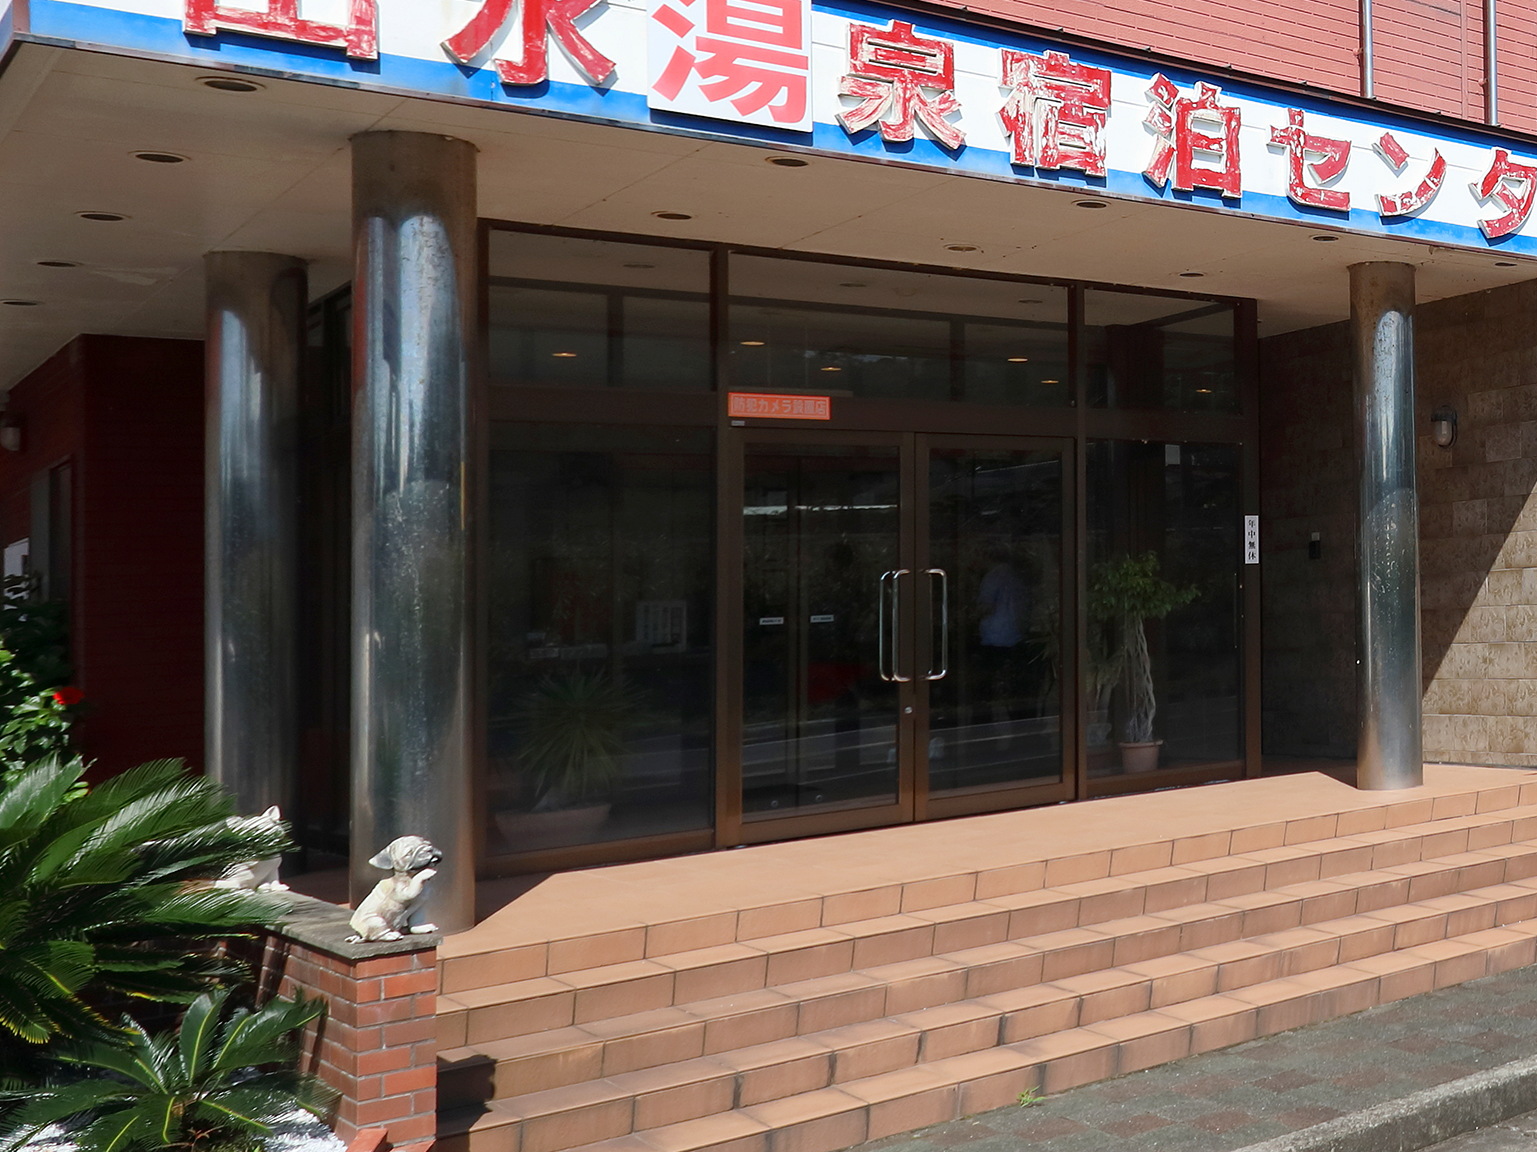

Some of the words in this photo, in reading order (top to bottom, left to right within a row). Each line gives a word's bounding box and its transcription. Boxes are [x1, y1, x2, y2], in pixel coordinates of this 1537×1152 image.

[732, 396, 827, 415] 防犯カメラ設置店
[1247, 519, 1257, 560] 年中無休
